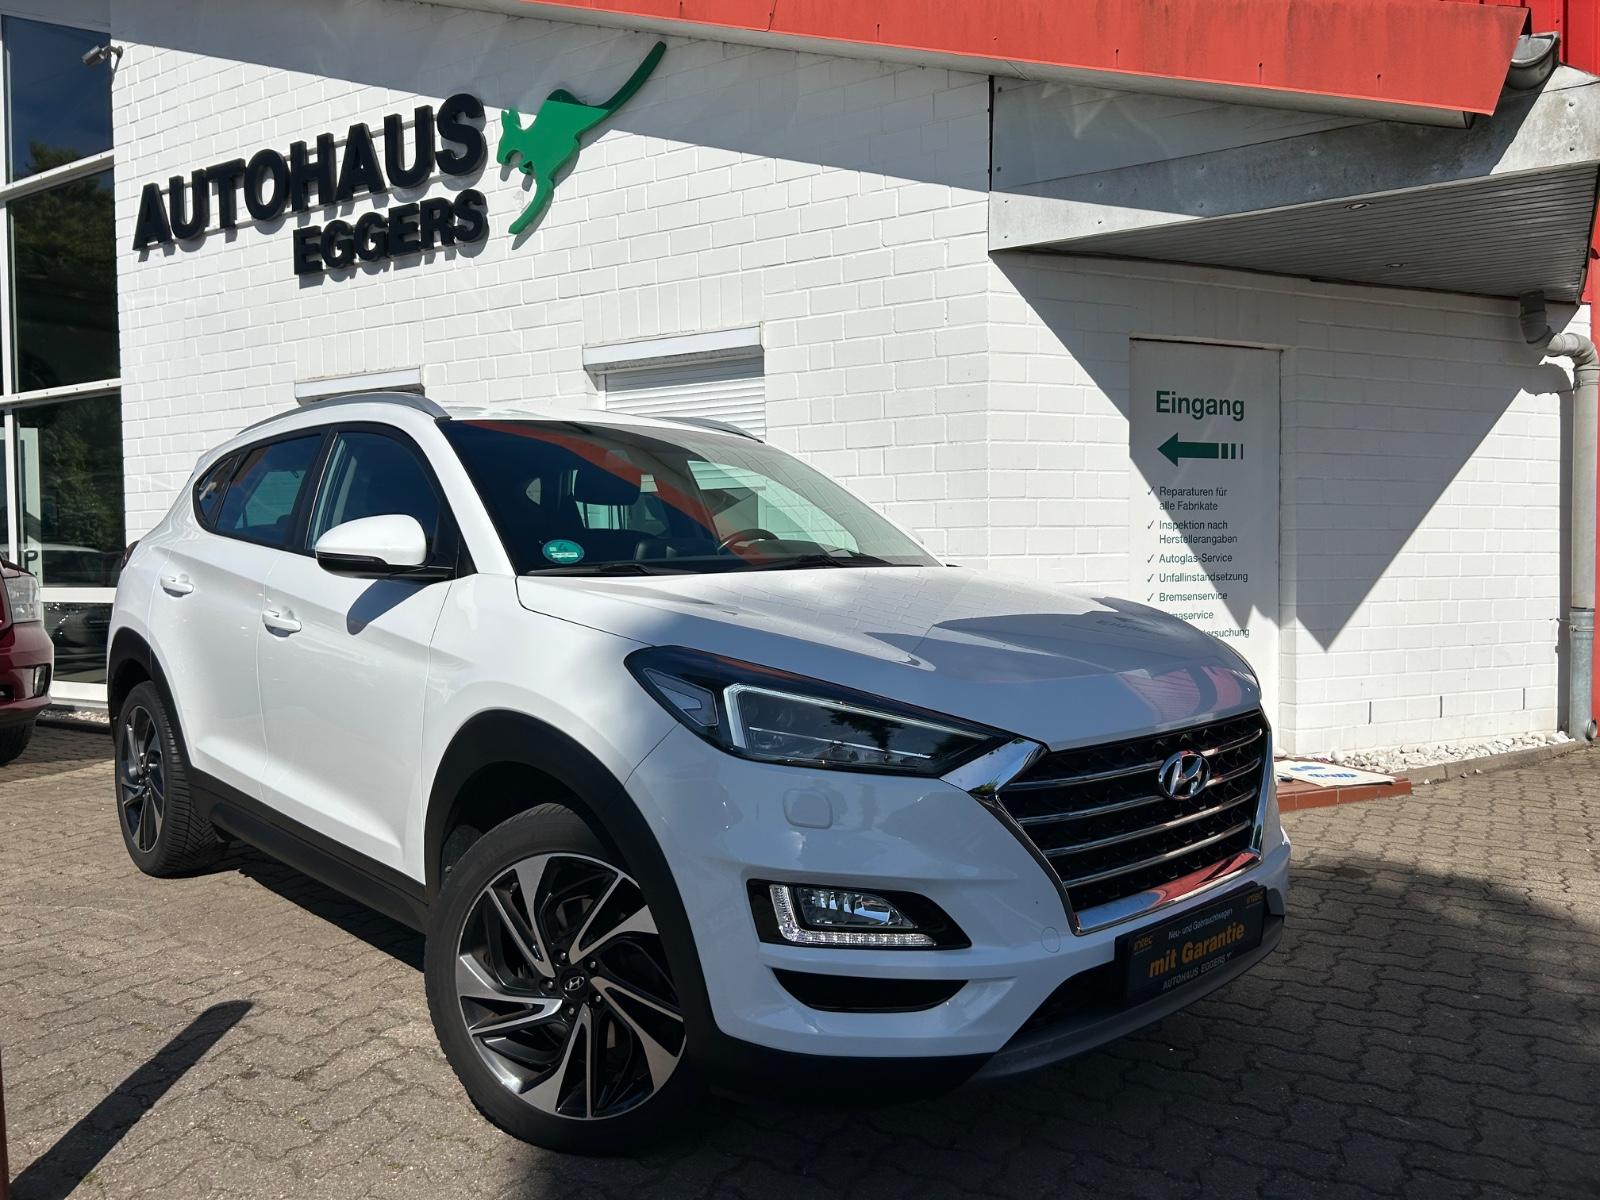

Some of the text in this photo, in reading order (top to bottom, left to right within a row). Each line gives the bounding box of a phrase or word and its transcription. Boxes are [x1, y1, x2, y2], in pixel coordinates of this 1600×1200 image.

[133, 93, 486, 250] AUTOHAUS
[293, 189, 489, 275] EGGERS
[1156, 390, 1244, 421] Eingang
[1159, 486, 1227, 498] Reparaturen für
[1159, 501, 1218, 511] alle Fabrikate
[1159, 520, 1228, 531] Inspektion nach
[1159, 534, 1238, 545] Herstellerangaben
[1159, 553, 1233, 564] Autoglas-Service
[1159, 572, 1249, 583] Unfallinstandsetzung
[1159, 592, 1228, 602] Bremsenservice
[1149, 921, 1245, 978] mit Garantie
[1162, 967, 1199, 991] AUTOHAUS
